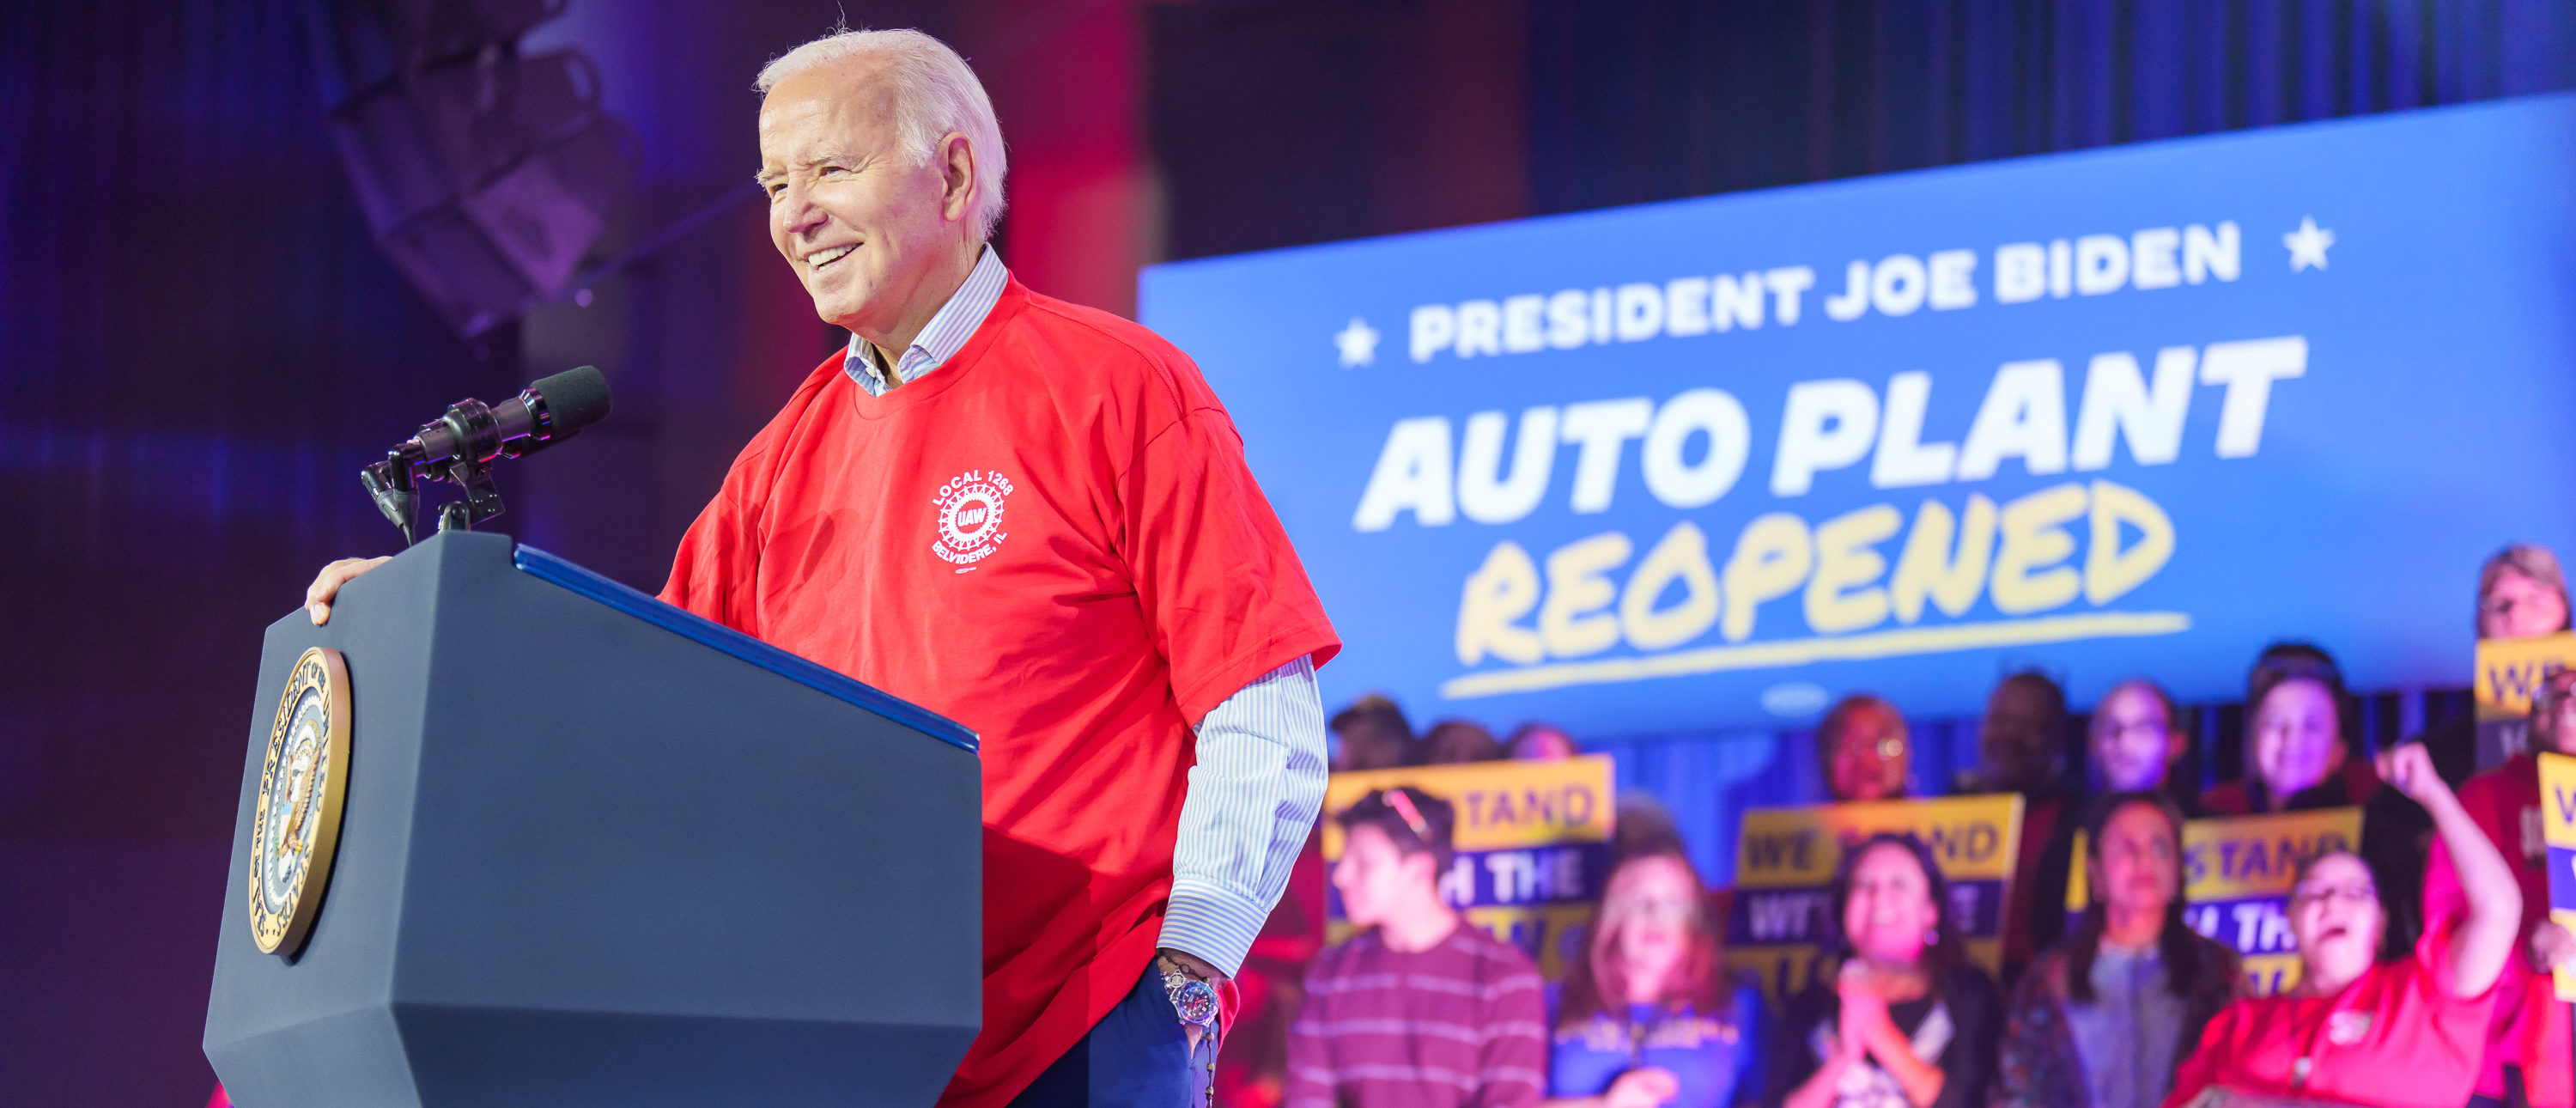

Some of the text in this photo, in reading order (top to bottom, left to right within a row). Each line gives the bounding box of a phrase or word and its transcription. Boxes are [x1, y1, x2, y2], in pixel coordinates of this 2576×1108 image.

[1411, 222, 2240, 363] PRESIDENT JOE BIDEN
[1352, 335, 2308, 532] AUTO PLANT
[932, 470, 1014, 506] LOCAL 1268
[957, 507, 987, 527] UAW
[932, 532, 1008, 565] BELVIDERE, IL
[1455, 479, 2174, 666] REOPENED
[262, 661, 312, 796] PRESIDENT
[1466, 785, 1593, 830] TAND
[1485, 850, 1583, 903] THE
